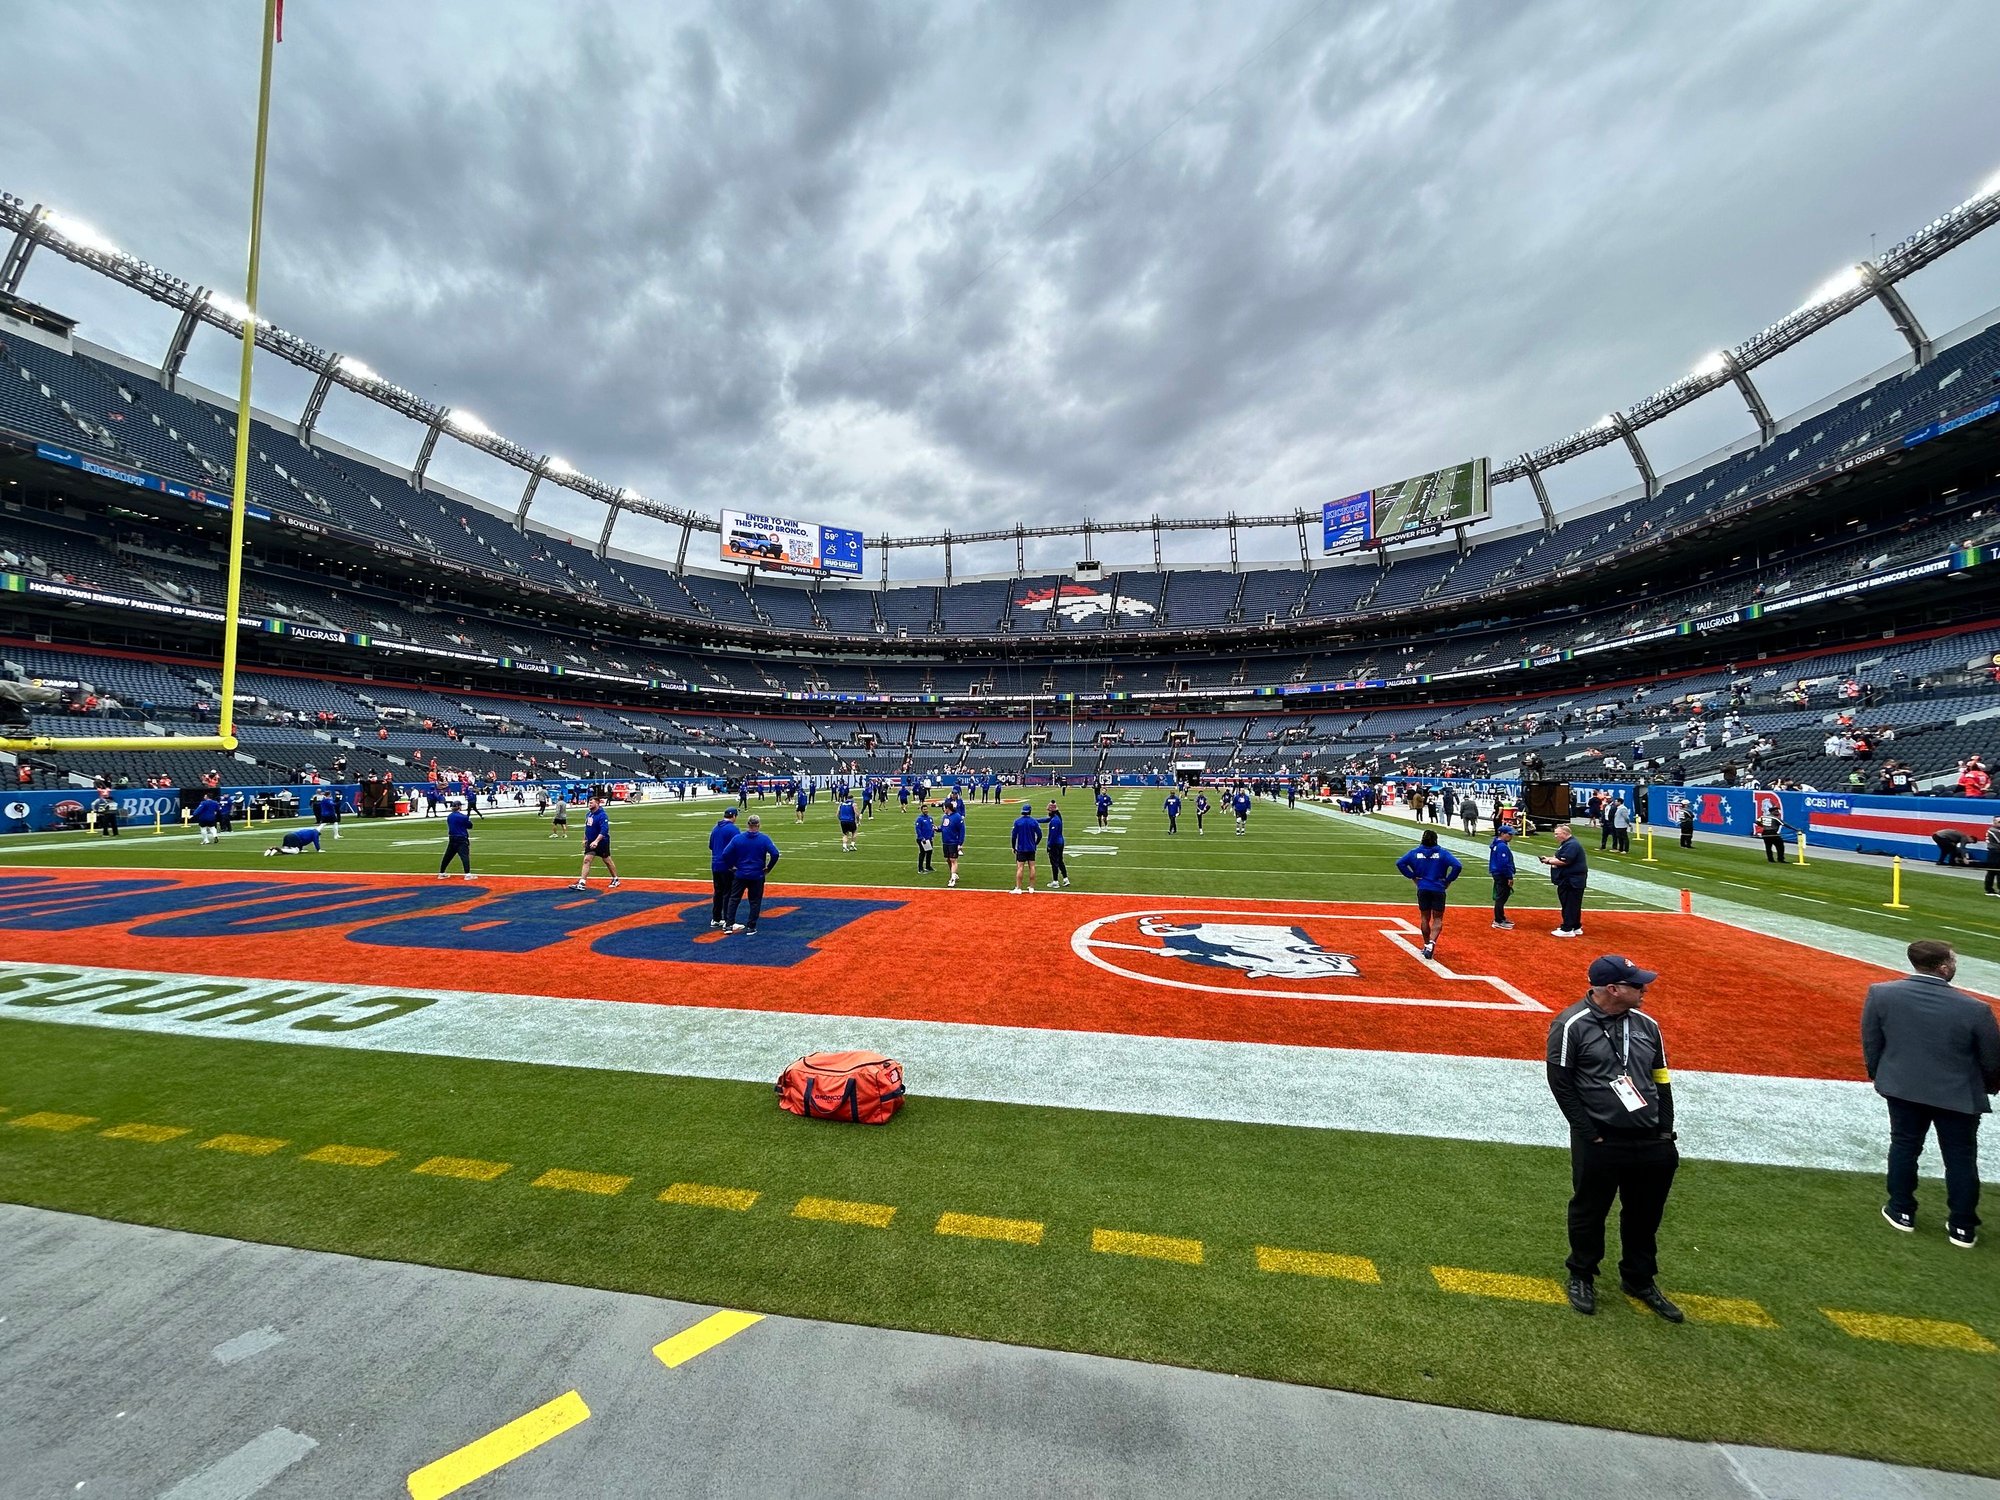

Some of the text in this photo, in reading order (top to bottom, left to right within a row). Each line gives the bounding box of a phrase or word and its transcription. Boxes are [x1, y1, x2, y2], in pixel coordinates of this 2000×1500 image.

[1855, 447, 1886, 465] ODOMS
[1774, 478, 1809, 497] SHANAHAN
[187, 489, 206, 503] 45
[1325, 501, 1368, 520] KICKOFF
[1723, 505, 1744, 519] BAILEY
[288, 519, 320, 532] BOWLEN
[734, 519, 808, 537] THIS FORD BRONCO.
[745, 513, 799, 529] ENTER TO WIN
[1332, 535, 1364, 548] EMPOWER
[1381, 526, 1437, 544] EMPOWER FIELD
[391, 547, 413, 558] THOMAS
[781, 565, 811, 574] EMPOWER
[825, 558, 857, 569] BUD LIGHT
[1764, 560, 1950, 613] HOMETOWN ENERGY PARTNER OF BRONCOS COUNTRY
[30, 582, 92, 600] HOMETOWN
[93, 593, 130, 607] ENERGY
[131, 599, 172, 613] PARTNER
[172, 606, 185, 615] OF
[186, 609, 225, 622] BRONCOS
[1696, 615, 1733, 631] TALLGRASS
[291, 627, 338, 641] TALLGRASS
[1654, 628, 1676, 639] COUNTRY
[372, 639, 404, 650] HOMETOWN
[405, 644, 424, 653] ENERGY
[425, 647, 447, 657] PARTNER
[455, 653, 477, 661] BRONCOS
[477, 656, 499, 664] COUNTRY
[516, 662, 544, 673] TALLGRASS
[1534, 655, 1556, 666] TALLGRASS
[42, 680, 79, 689] CAMPOS
[661, 682, 684, 691] TALLGRASS
[1386, 678, 1413, 687] TALLGRASS
[122, 797, 180, 817] BRON
[1812, 798, 1849, 809] CBS NFL
[0, 875, 912, 967] BRON
[0, 968, 439, 1032] CHOOS
